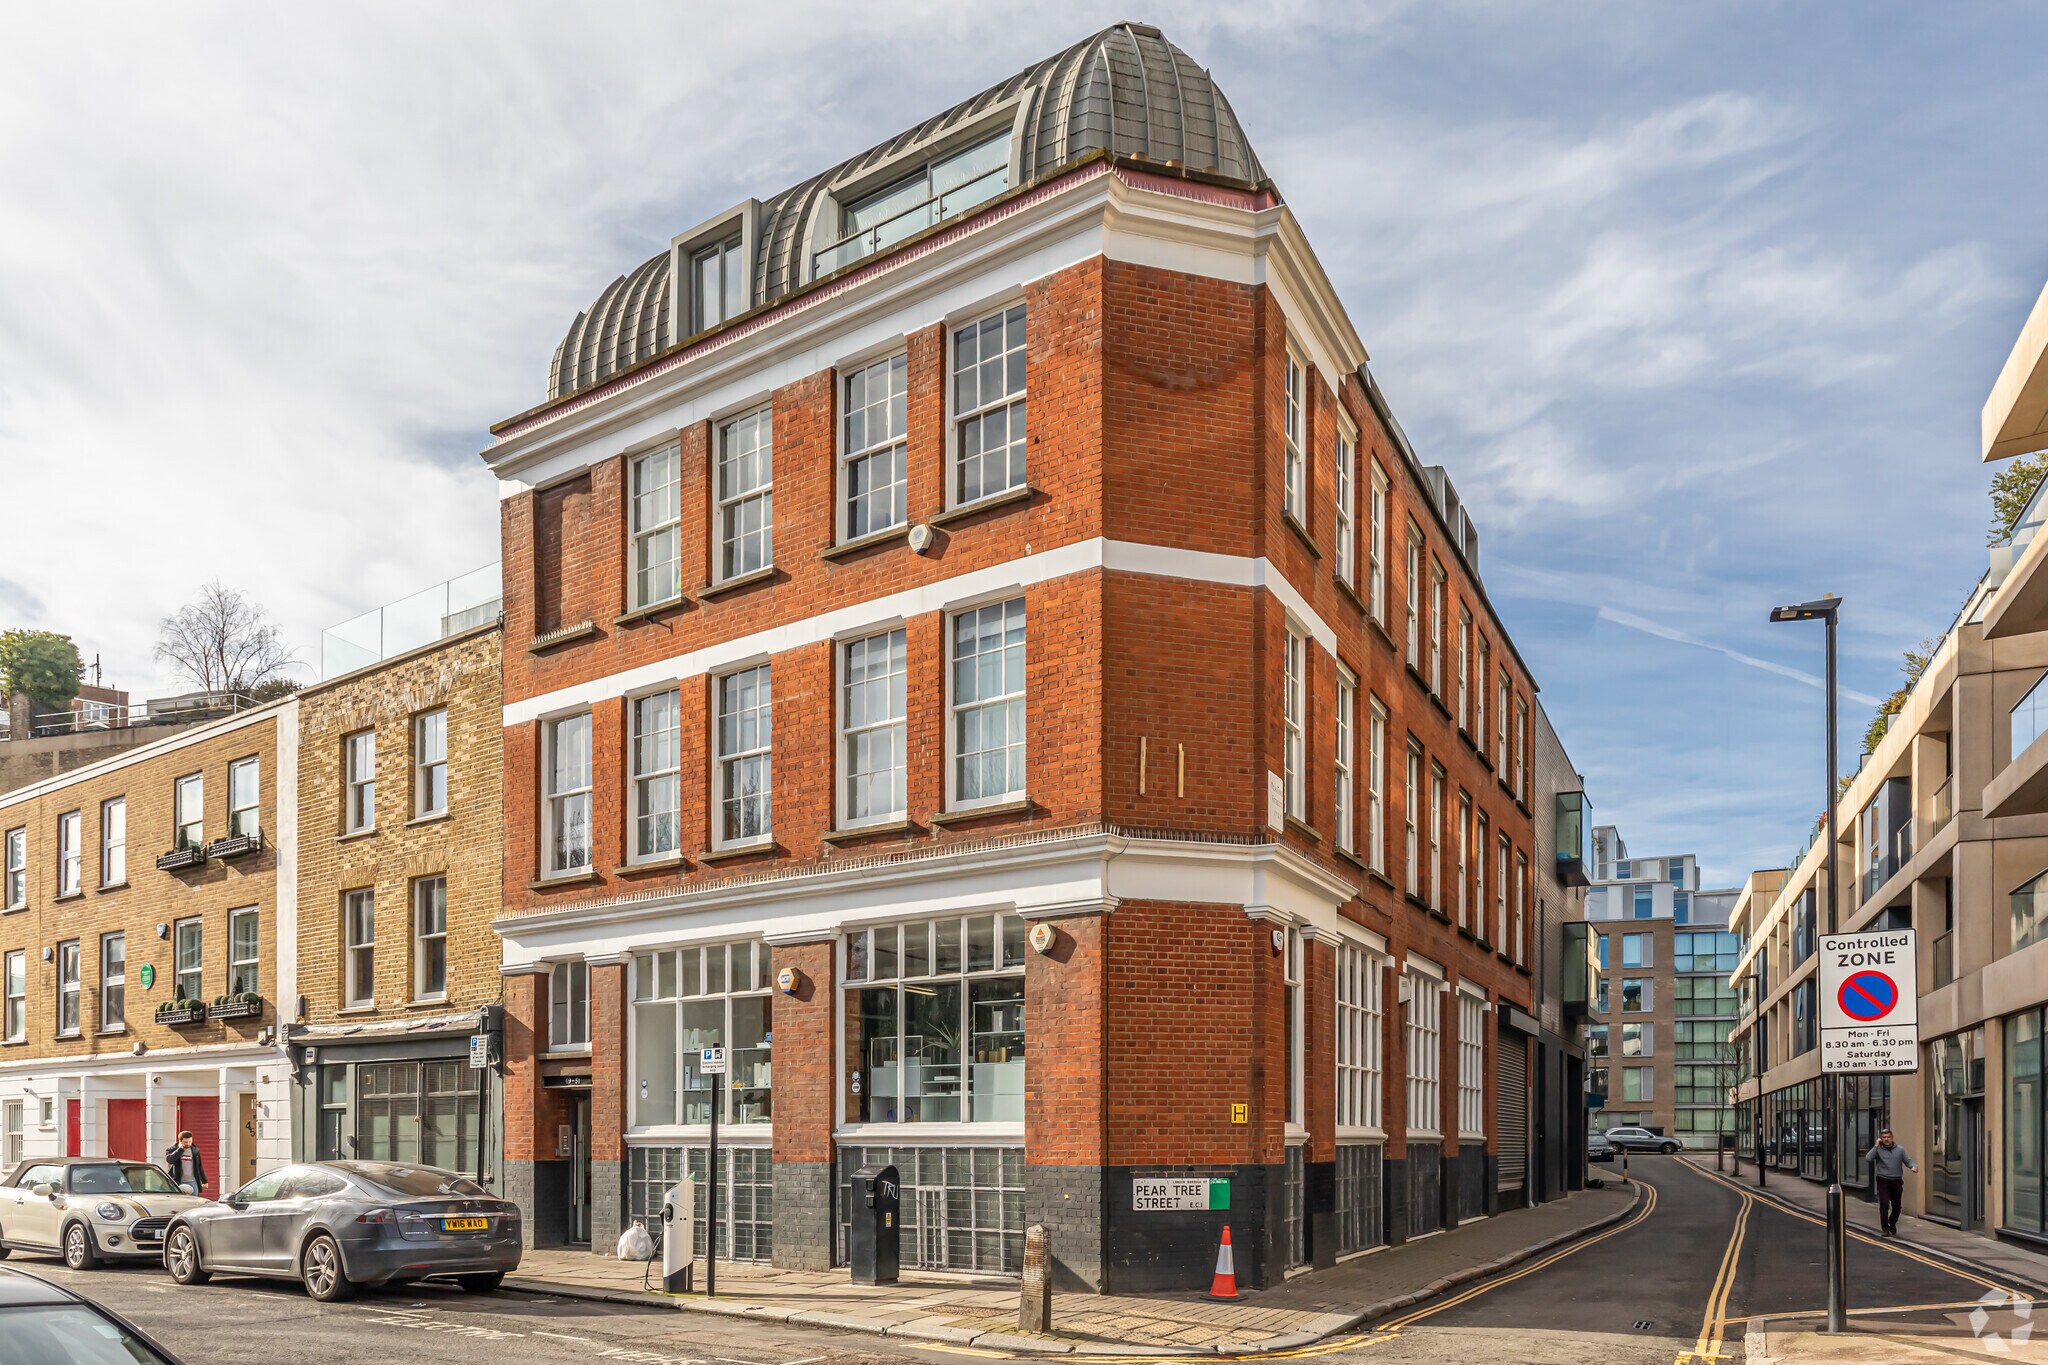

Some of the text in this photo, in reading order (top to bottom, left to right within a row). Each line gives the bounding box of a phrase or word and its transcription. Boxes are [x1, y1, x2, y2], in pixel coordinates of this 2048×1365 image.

[1826, 935, 1908, 951] Controlled
[1837, 951, 1896, 967] ZONE
[1848, 1030, 1869, 1038] Mon
[1876, 1029, 1890, 1037] Fri
[1825, 1041, 1849, 1049] 8.30
[1872, 1038, 1896, 1047] 6.30
[1898, 1039, 1914, 1047] pm
[1847, 1050, 1892, 1058] Saturday
[1827, 1060, 1850, 1068] 8.30
[1874, 1059, 1895, 1067] 1.30
[1897, 1059, 1913, 1067] pm
[1136, 1185, 1202, 1196] PEAR TREE
[1136, 1198, 1181, 1208] STREET
[446, 1219, 466, 1228] YW16
